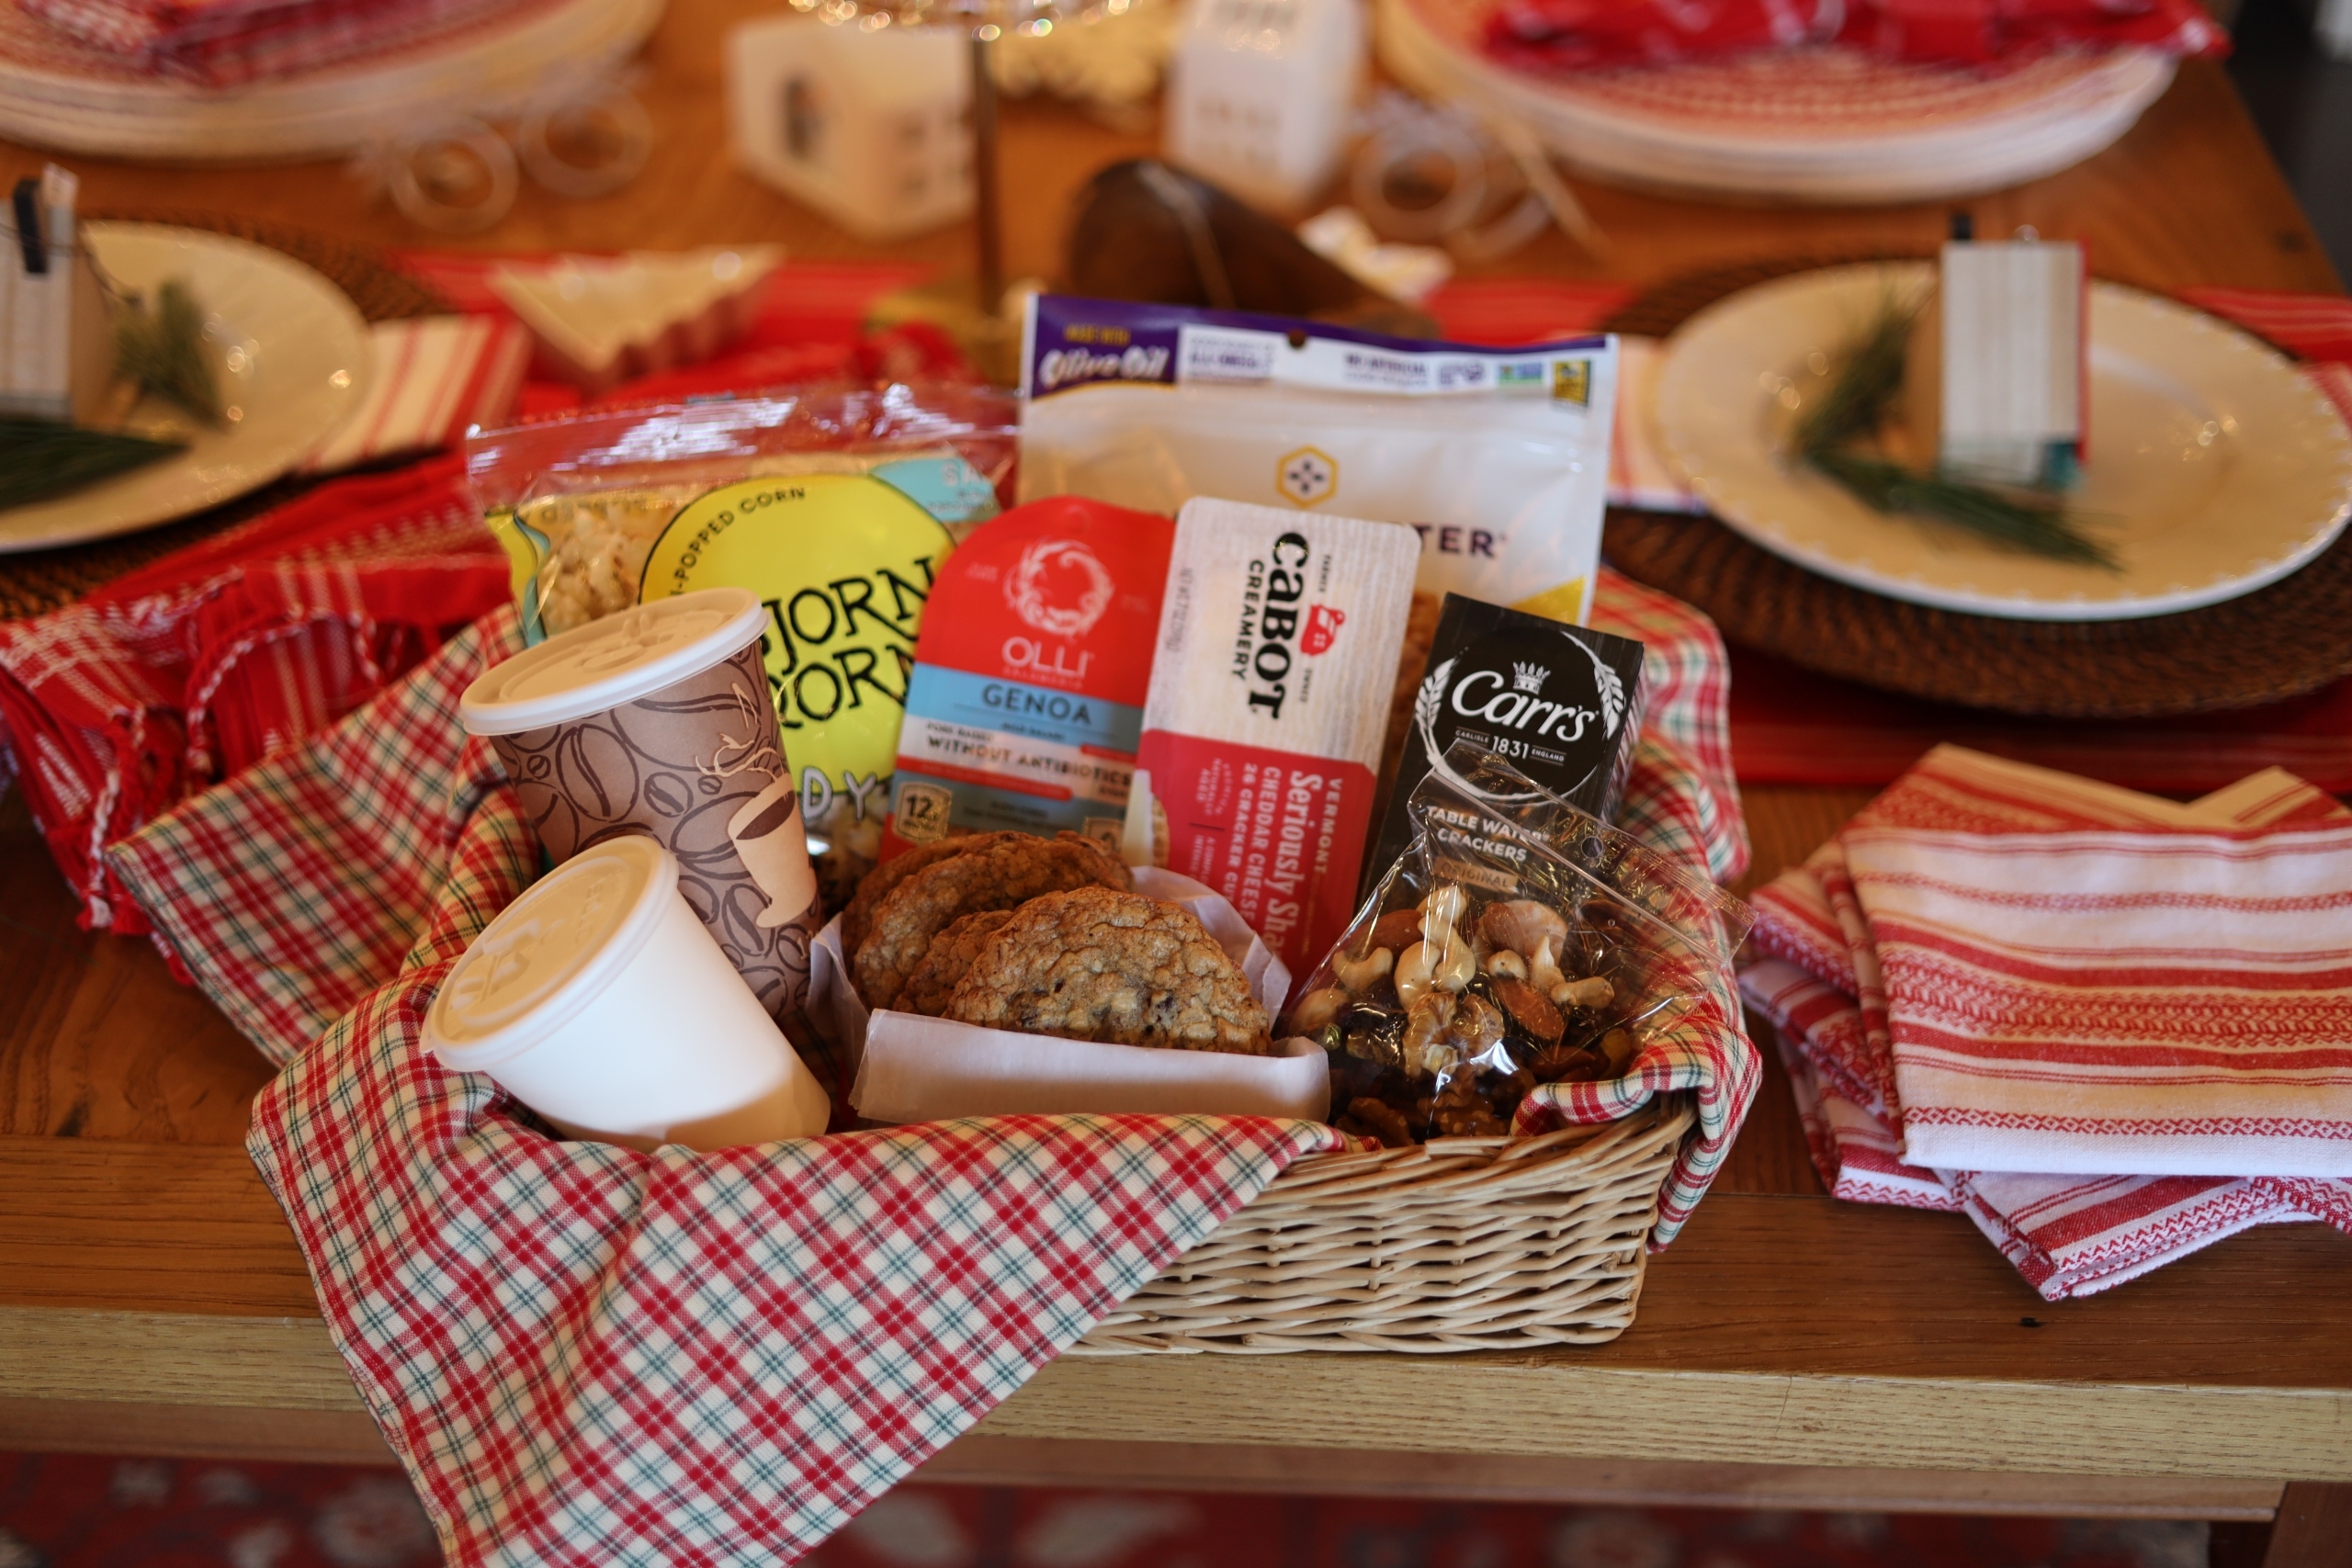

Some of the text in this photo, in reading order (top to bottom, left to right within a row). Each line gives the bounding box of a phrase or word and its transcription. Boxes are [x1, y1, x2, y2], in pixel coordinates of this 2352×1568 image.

[1039, 346, 1121, 388] Olive
[1121, 344, 1170, 379] Oil
[738, 486, 807, 515] CORN
[761, 556, 934, 676] JORN
[1230, 558, 1265, 681] CREAMERY
[1001, 636, 1090, 680] OLLI
[981, 682, 1093, 726] GENOA
[925, 735, 1012, 763] WITHOUT
[1016, 751, 1132, 787] ANTIBIOTICS
[1454, 728, 1565, 762] CARLISLE 1831 ENGLAND
[801, 765, 877, 822] DY
[906, 794, 933, 818] 12
[1250, 765, 1281, 850] CHEDDAR
[1424, 805, 1478, 829] TABLE
[1227, 787, 1253, 868] CRACKER
[1263, 768, 1323, 897] Seriously
[1313, 776, 1341, 875] VERMONT
[1435, 827, 1528, 863] CRACKERS
